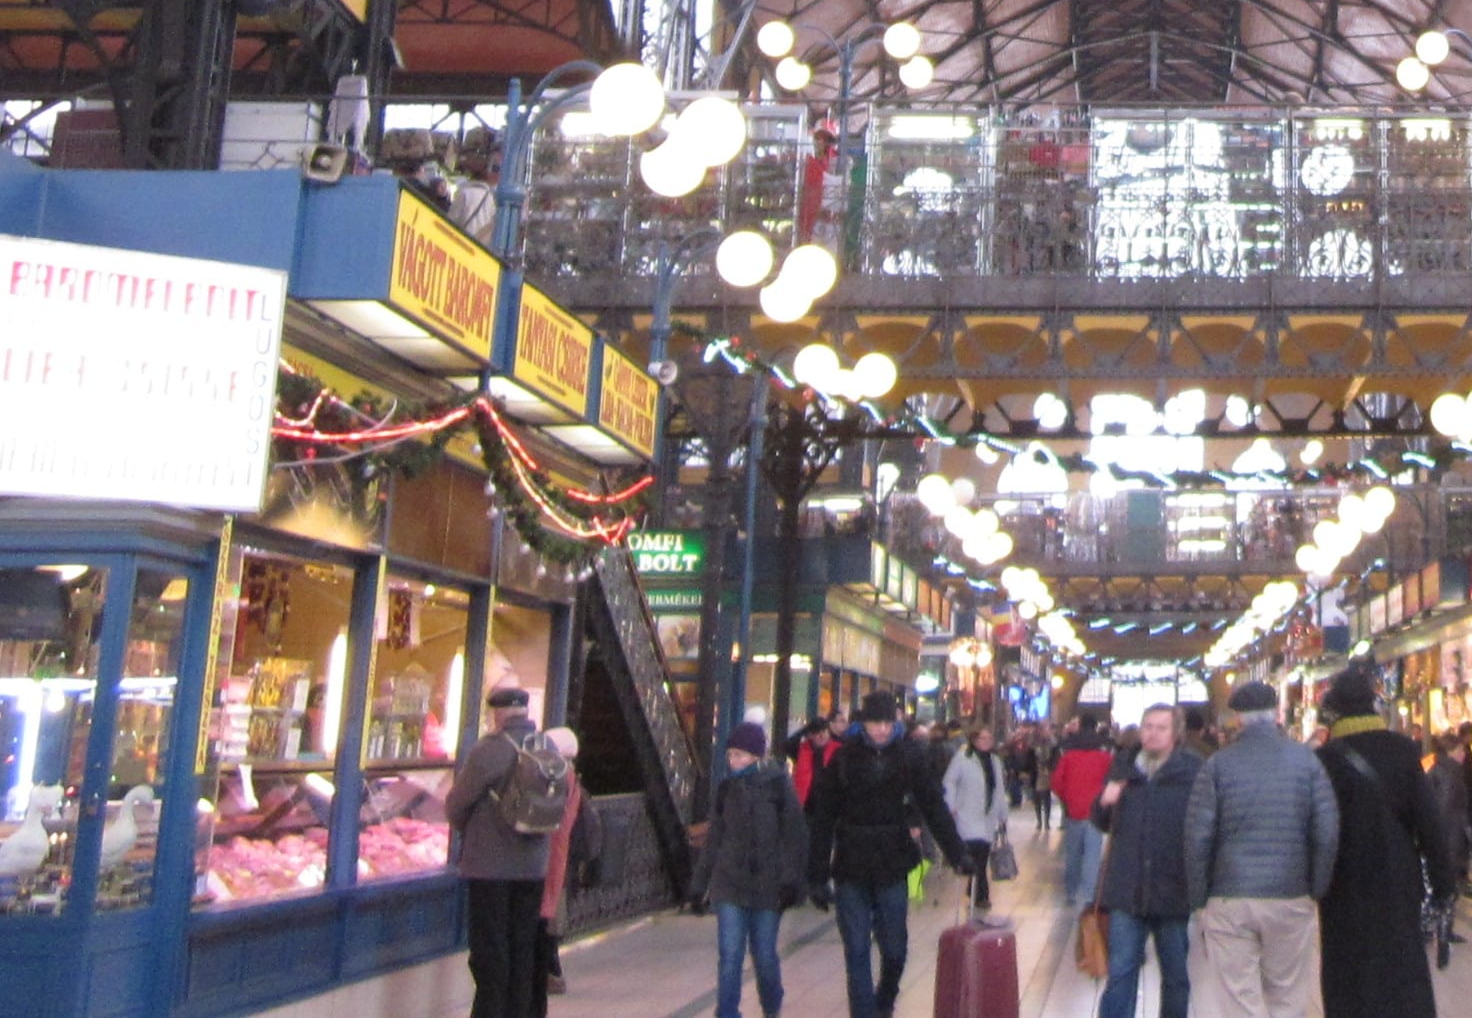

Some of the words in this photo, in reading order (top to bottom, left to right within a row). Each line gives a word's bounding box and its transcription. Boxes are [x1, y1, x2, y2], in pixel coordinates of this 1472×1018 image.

[399, 207, 447, 310] VÁGOTT
[627, 533, 684, 551] OMFI
[638, 552, 699, 572] BOLT
